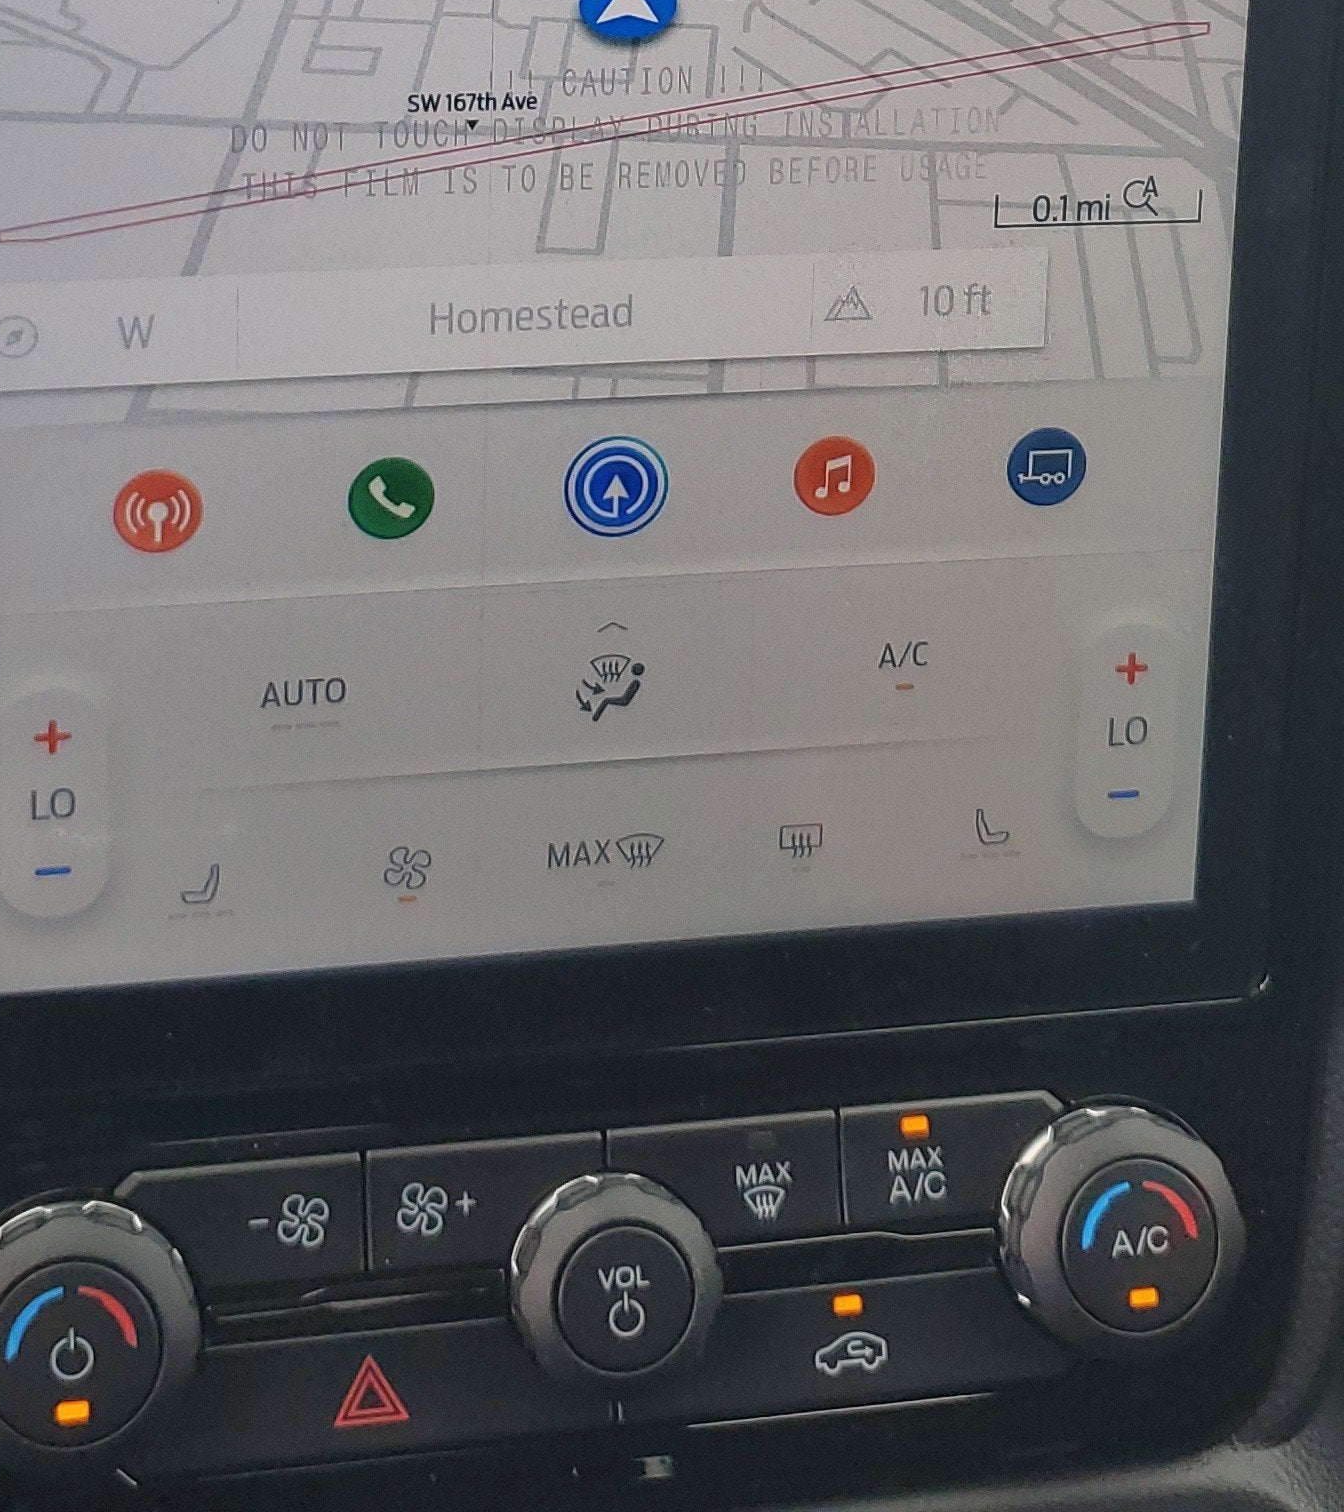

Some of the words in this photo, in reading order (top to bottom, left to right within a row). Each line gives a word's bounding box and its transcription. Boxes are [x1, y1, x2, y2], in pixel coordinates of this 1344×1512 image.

[562, 65, 692, 96] CAUTION
[406, 93, 442, 113] SW
[445, 92, 496, 113] 167th
[500, 92, 538, 112] Ave
[231, 123, 268, 153] DO
[293, 122, 351, 152] NOT
[375, 119, 468, 149] TOUCH
[493, 114, 624, 145] DISPLAY
[647, 112, 757, 140] DURING
[784, 106, 1001, 138] INSTALLATION
[242, 171, 317, 199] THIS
[343, 168, 419, 198] FILM
[444, 166, 477, 195] IS
[502, 164, 536, 193] TO
[560, 162, 594, 191] BE
[618, 158, 746, 190] REMOVED
[769, 154, 878, 186] BEFORE
[900, 152, 988, 182] USAGE
[1032, 194, 1068, 222] 0.1
[1076, 193, 1111, 221] mi
[430, 293, 633, 335] Homestead
[919, 284, 955, 317] 10
[961, 282, 992, 317] ft
[118, 315, 155, 350] W
[878, 641, 929, 671] A/C
[260, 677, 347, 709] AUTO
[1107, 716, 1148, 748] LO
[30, 787, 76, 821] LO
[547, 838, 611, 870] MAX
[735, 1161, 792, 1187] MAX
[887, 1144, 943, 1172] MAX
[889, 1170, 947, 1205] A/C
[1111, 1225, 1170, 1258] A/C
[597, 1265, 650, 1291] VOL
